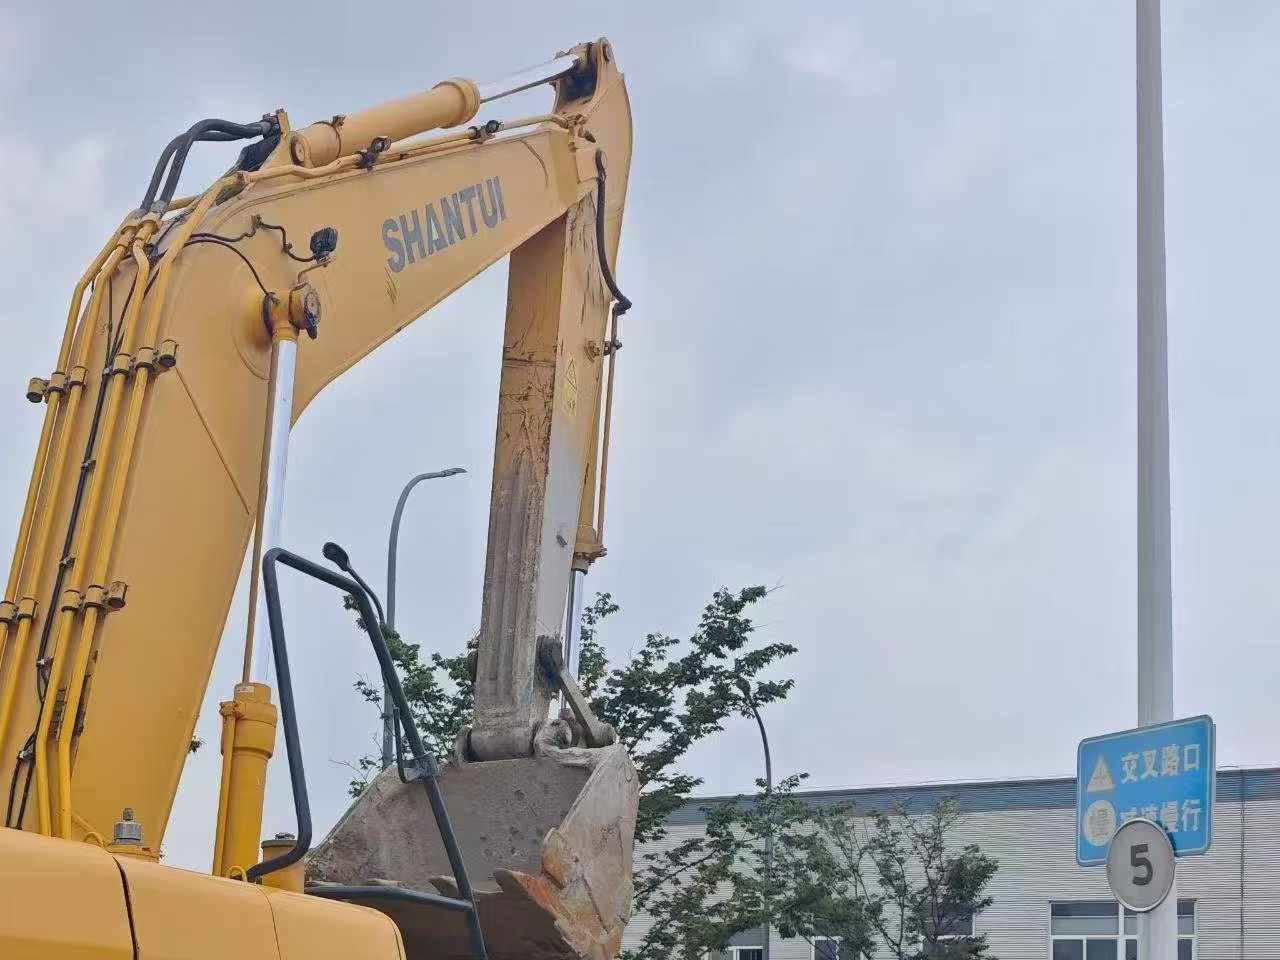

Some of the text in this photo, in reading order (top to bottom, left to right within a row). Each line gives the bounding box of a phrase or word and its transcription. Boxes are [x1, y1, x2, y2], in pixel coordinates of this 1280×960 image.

[382, 176, 507, 273] SHANTUI
[1120, 743, 1202, 784] 交叉路口
[1130, 843, 1154, 886] 5
